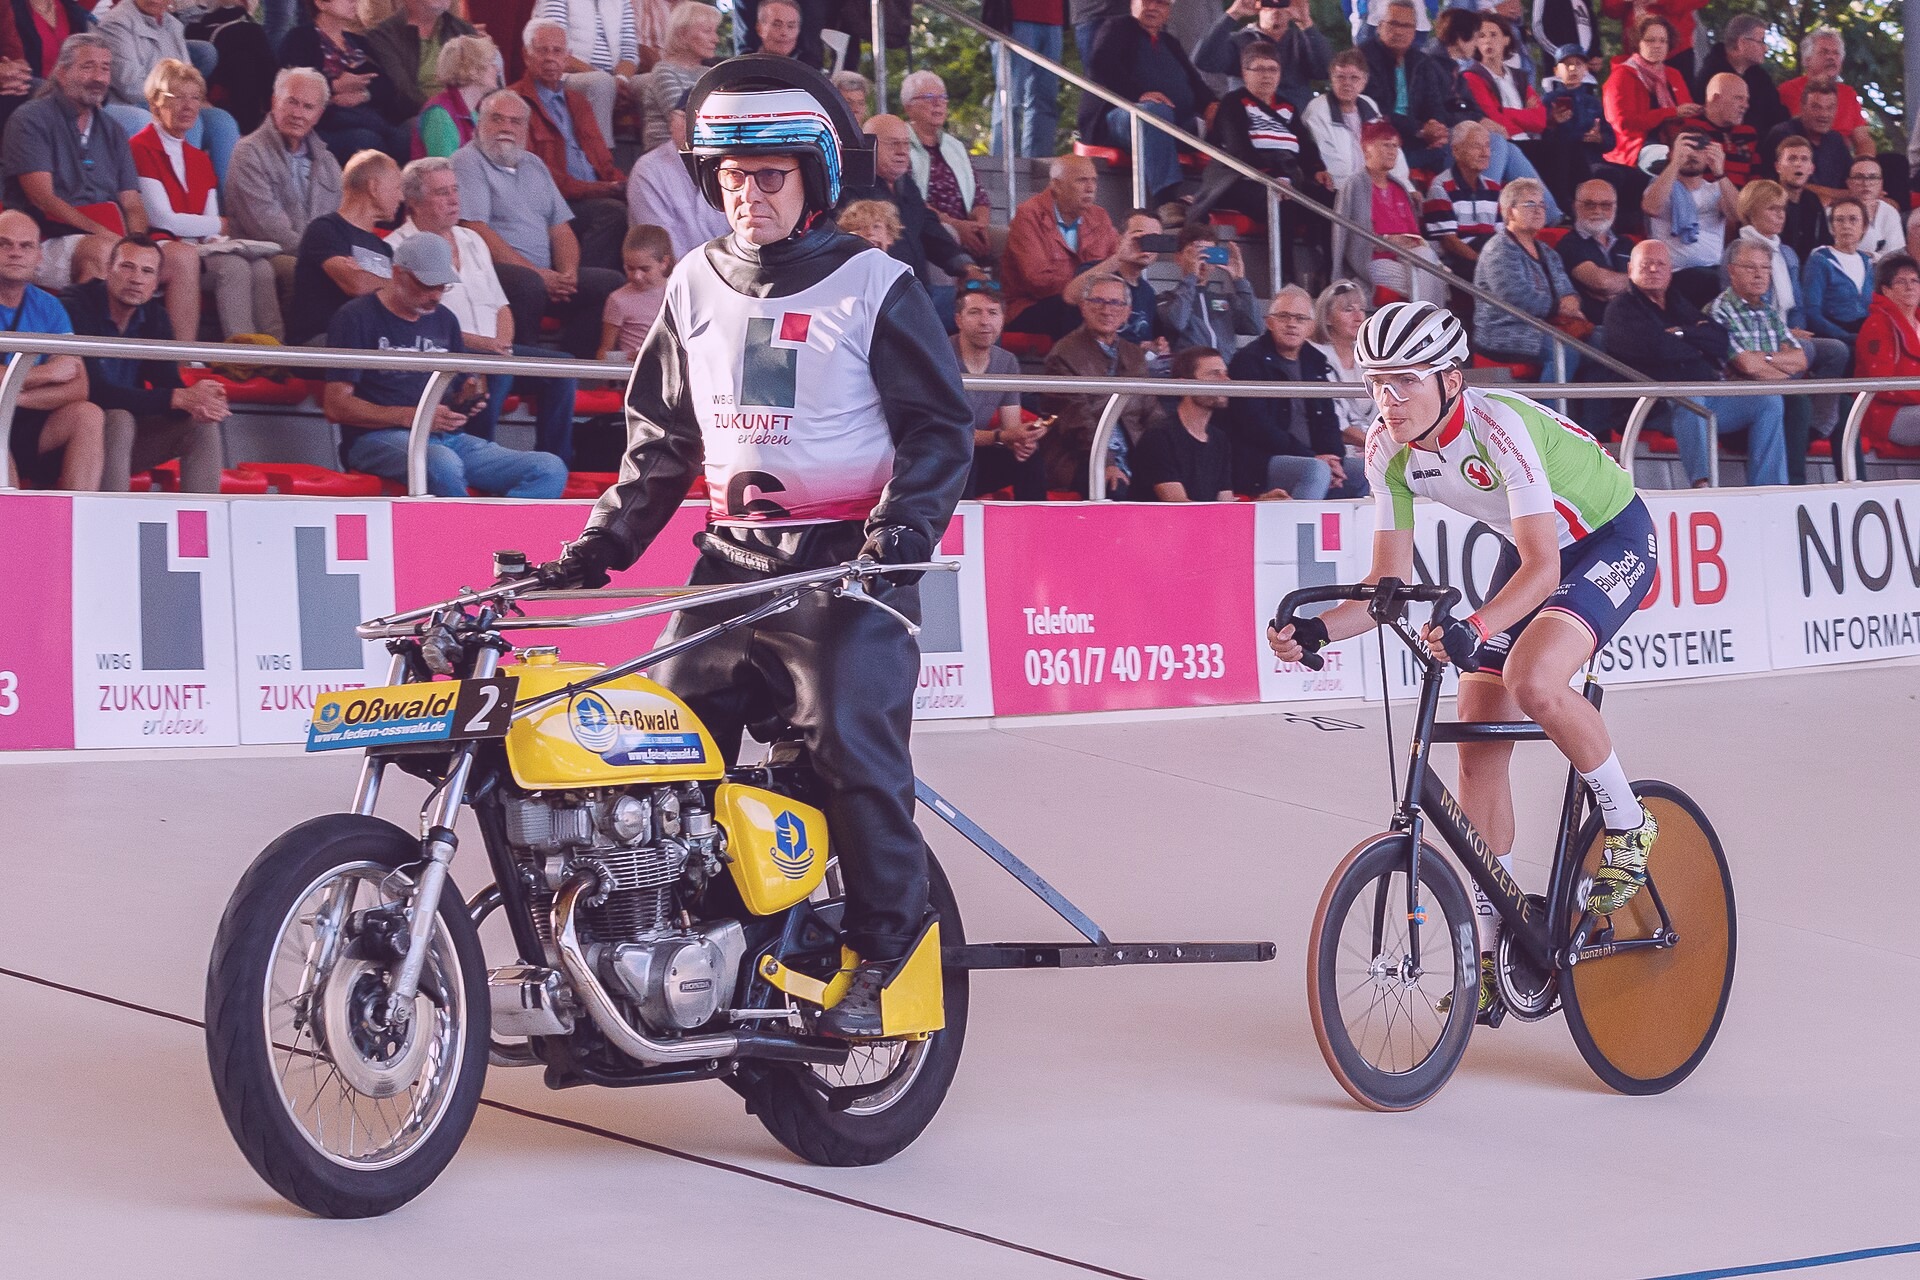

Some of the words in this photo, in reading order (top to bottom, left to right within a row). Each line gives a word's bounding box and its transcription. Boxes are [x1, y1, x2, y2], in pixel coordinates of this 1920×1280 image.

[712, 394, 734, 405] WBG
[714, 413, 793, 431] ZUKUNFT
[738, 429, 792, 446] erleben
[1489, 433, 1509, 456] BERLIN
[1625, 561, 1646, 588] Group
[1023, 606, 1095, 635] Telefon:
[95, 653, 132, 670] WBG
[256, 654, 292, 670] WBG
[1024, 646, 1106, 686] 0361/7
[1110, 645, 1143, 682] 40
[1144, 643, 1226, 681] 79-333
[919, 664, 964, 688] UNFT
[0, 670, 20, 716] 3
[98, 684, 207, 711] ZUKUNFT
[344, 692, 455, 725] Oßwald
[463, 685, 500, 732] 2
[619, 709, 680, 731] Oßwald
[142, 709, 208, 735] erleben
[314, 721, 447, 743] www.federn-osswald.de
[1440, 789, 1532, 924] MR-KONZEPTE
